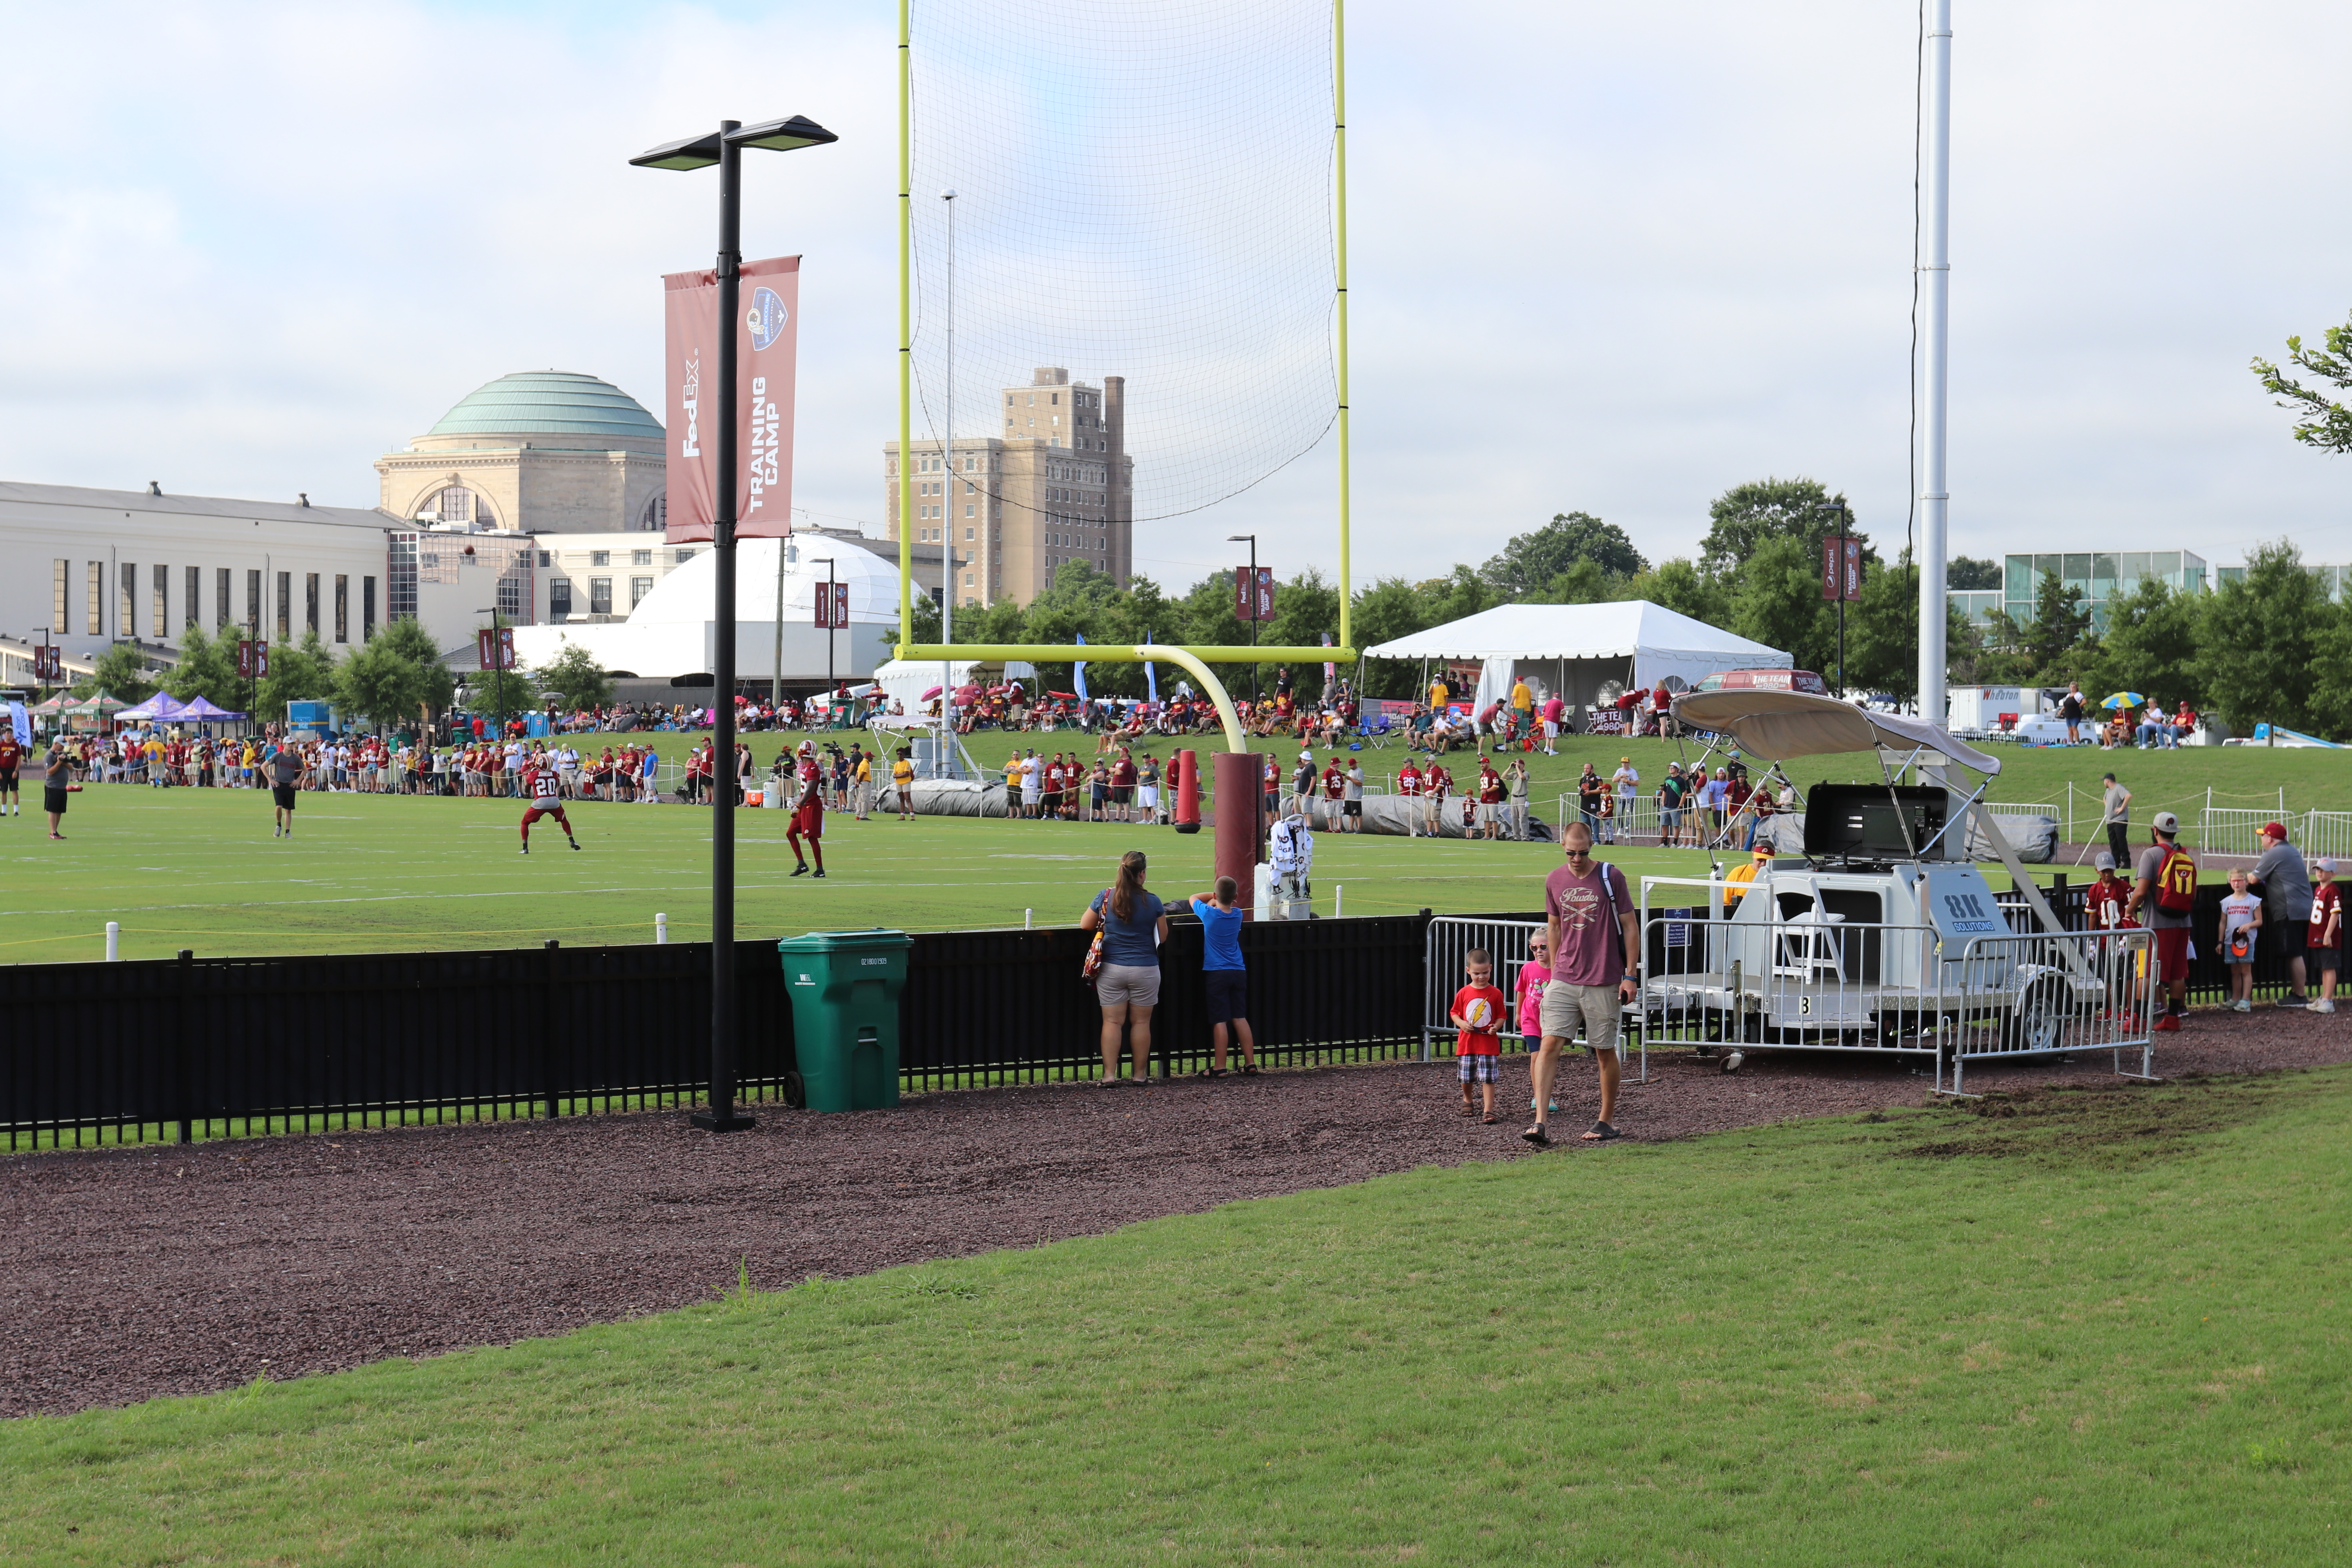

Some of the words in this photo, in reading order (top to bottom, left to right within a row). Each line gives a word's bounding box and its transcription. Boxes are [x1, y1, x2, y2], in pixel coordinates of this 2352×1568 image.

[682, 359, 701, 458] FedEx
[750, 376, 766, 513] TRAINING
[764, 403, 779, 486] CAMP
[1753, 675, 1768, 684] THE
[1769, 675, 1792, 684] TEAM
[1796, 677, 1808, 686] THE
[1808, 677, 1823, 688] TEAM
[1983, 689, 2019, 700] Wheaton
[1592, 711, 1608, 725] THE
[1608, 711, 1622, 720] TEA
[1604, 722, 1620, 731] 980
[307, 753, 315, 762] 80
[360, 753, 367, 762] 75
[1067, 768, 1074, 777] 11
[584, 774, 593, 783] 24
[1403, 777, 1415, 787] 29
[1425, 774, 1432, 786] 71
[535, 778, 556, 796] 20
[1559, 887, 1599, 902] Powder
[2100, 900, 2121, 925] 10
[2310, 899, 2324, 925] 6
[1954, 922, 1994, 931] SOLUTIONS
